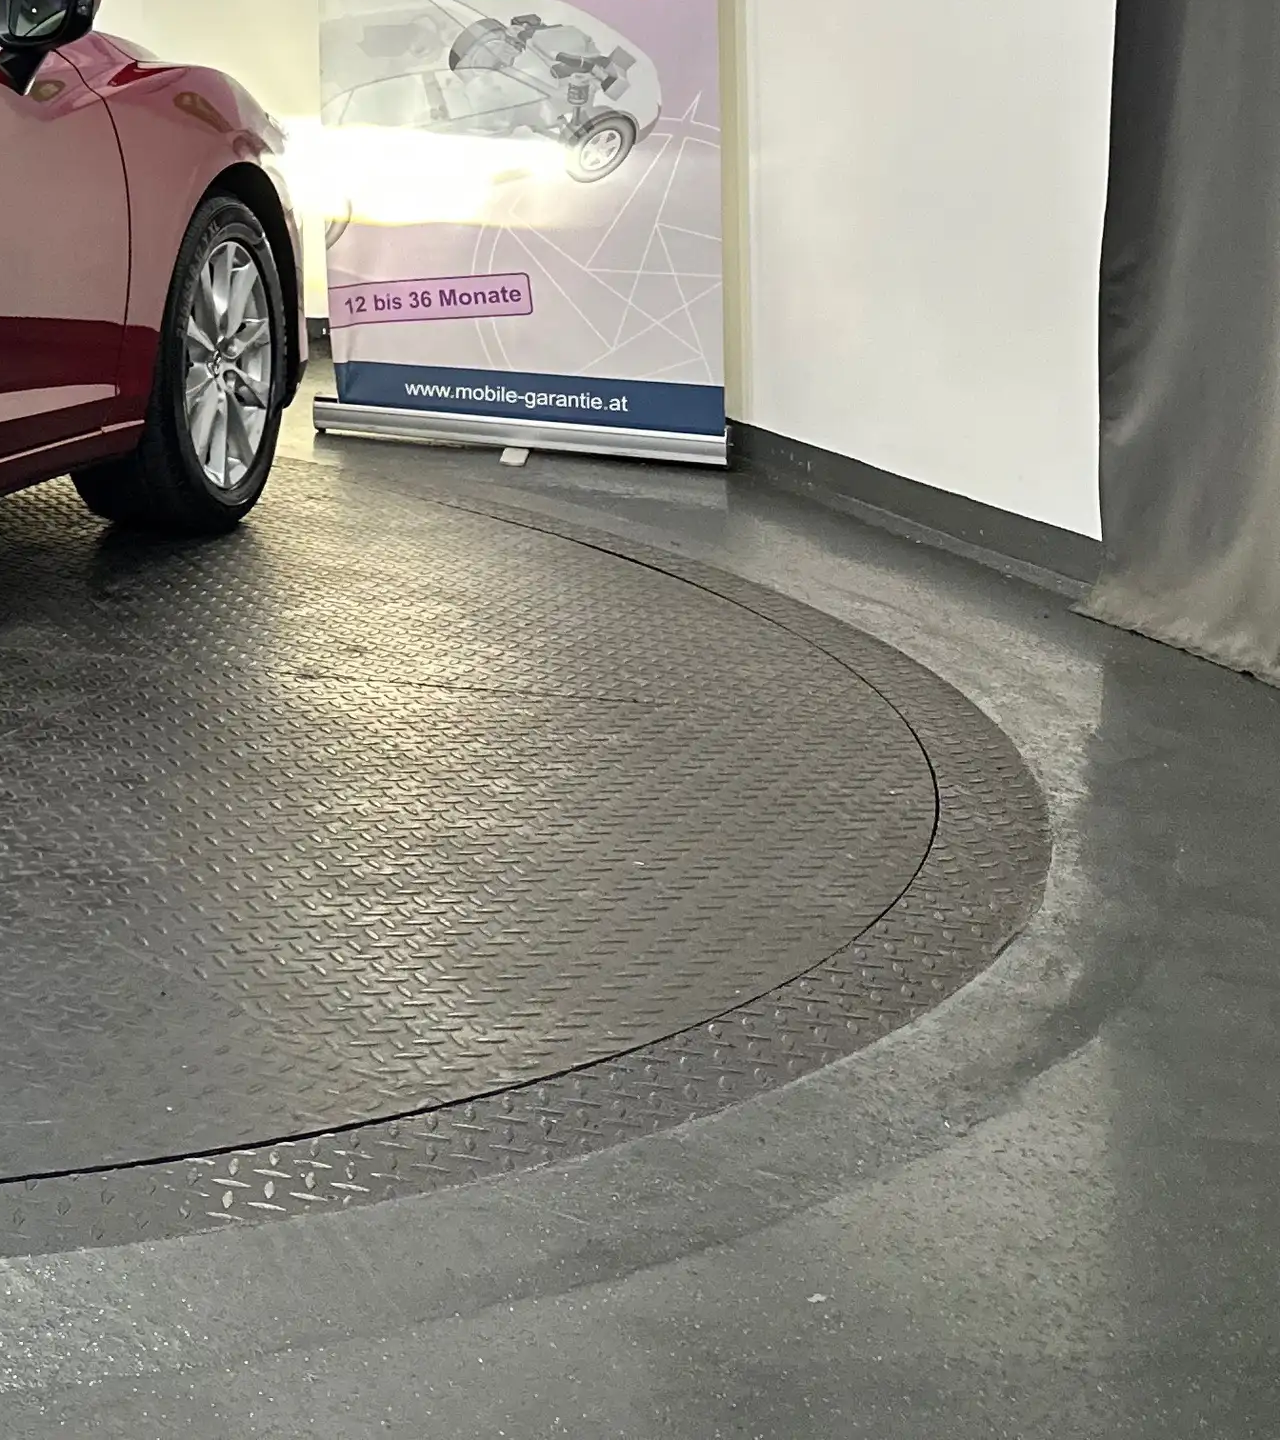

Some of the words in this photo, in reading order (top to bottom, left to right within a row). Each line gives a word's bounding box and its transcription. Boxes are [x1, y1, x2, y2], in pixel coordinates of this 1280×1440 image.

[345, 295, 368, 315] 12
[373, 292, 404, 312] bis
[408, 291, 432, 310] 36
[439, 285, 523, 307] Monate
[404, 381, 629, 413] www.mobile-garantie.at
